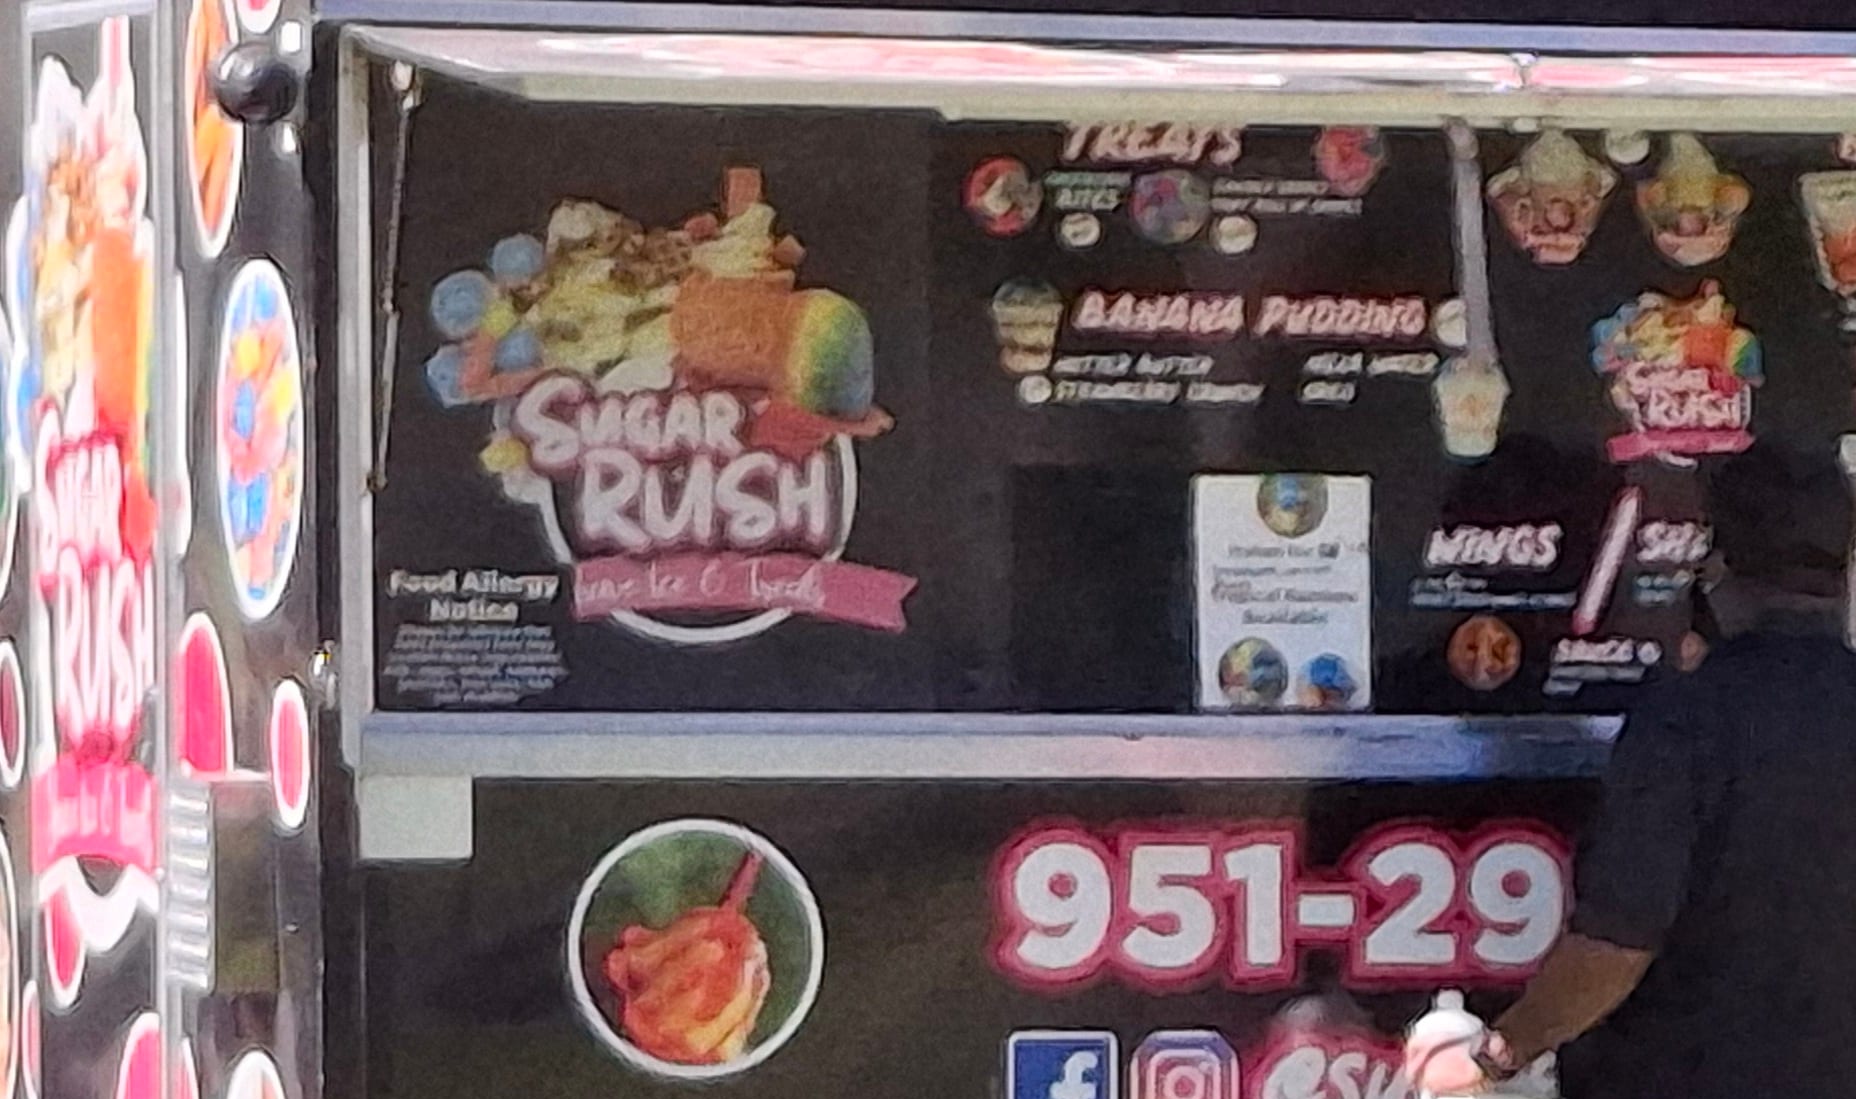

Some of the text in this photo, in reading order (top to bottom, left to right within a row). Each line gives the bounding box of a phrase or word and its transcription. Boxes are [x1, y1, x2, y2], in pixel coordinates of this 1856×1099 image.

[1072, 293, 1245, 334] BANANA
[516, 376, 748, 465] SUGAR
[580, 448, 828, 548] RUSH
